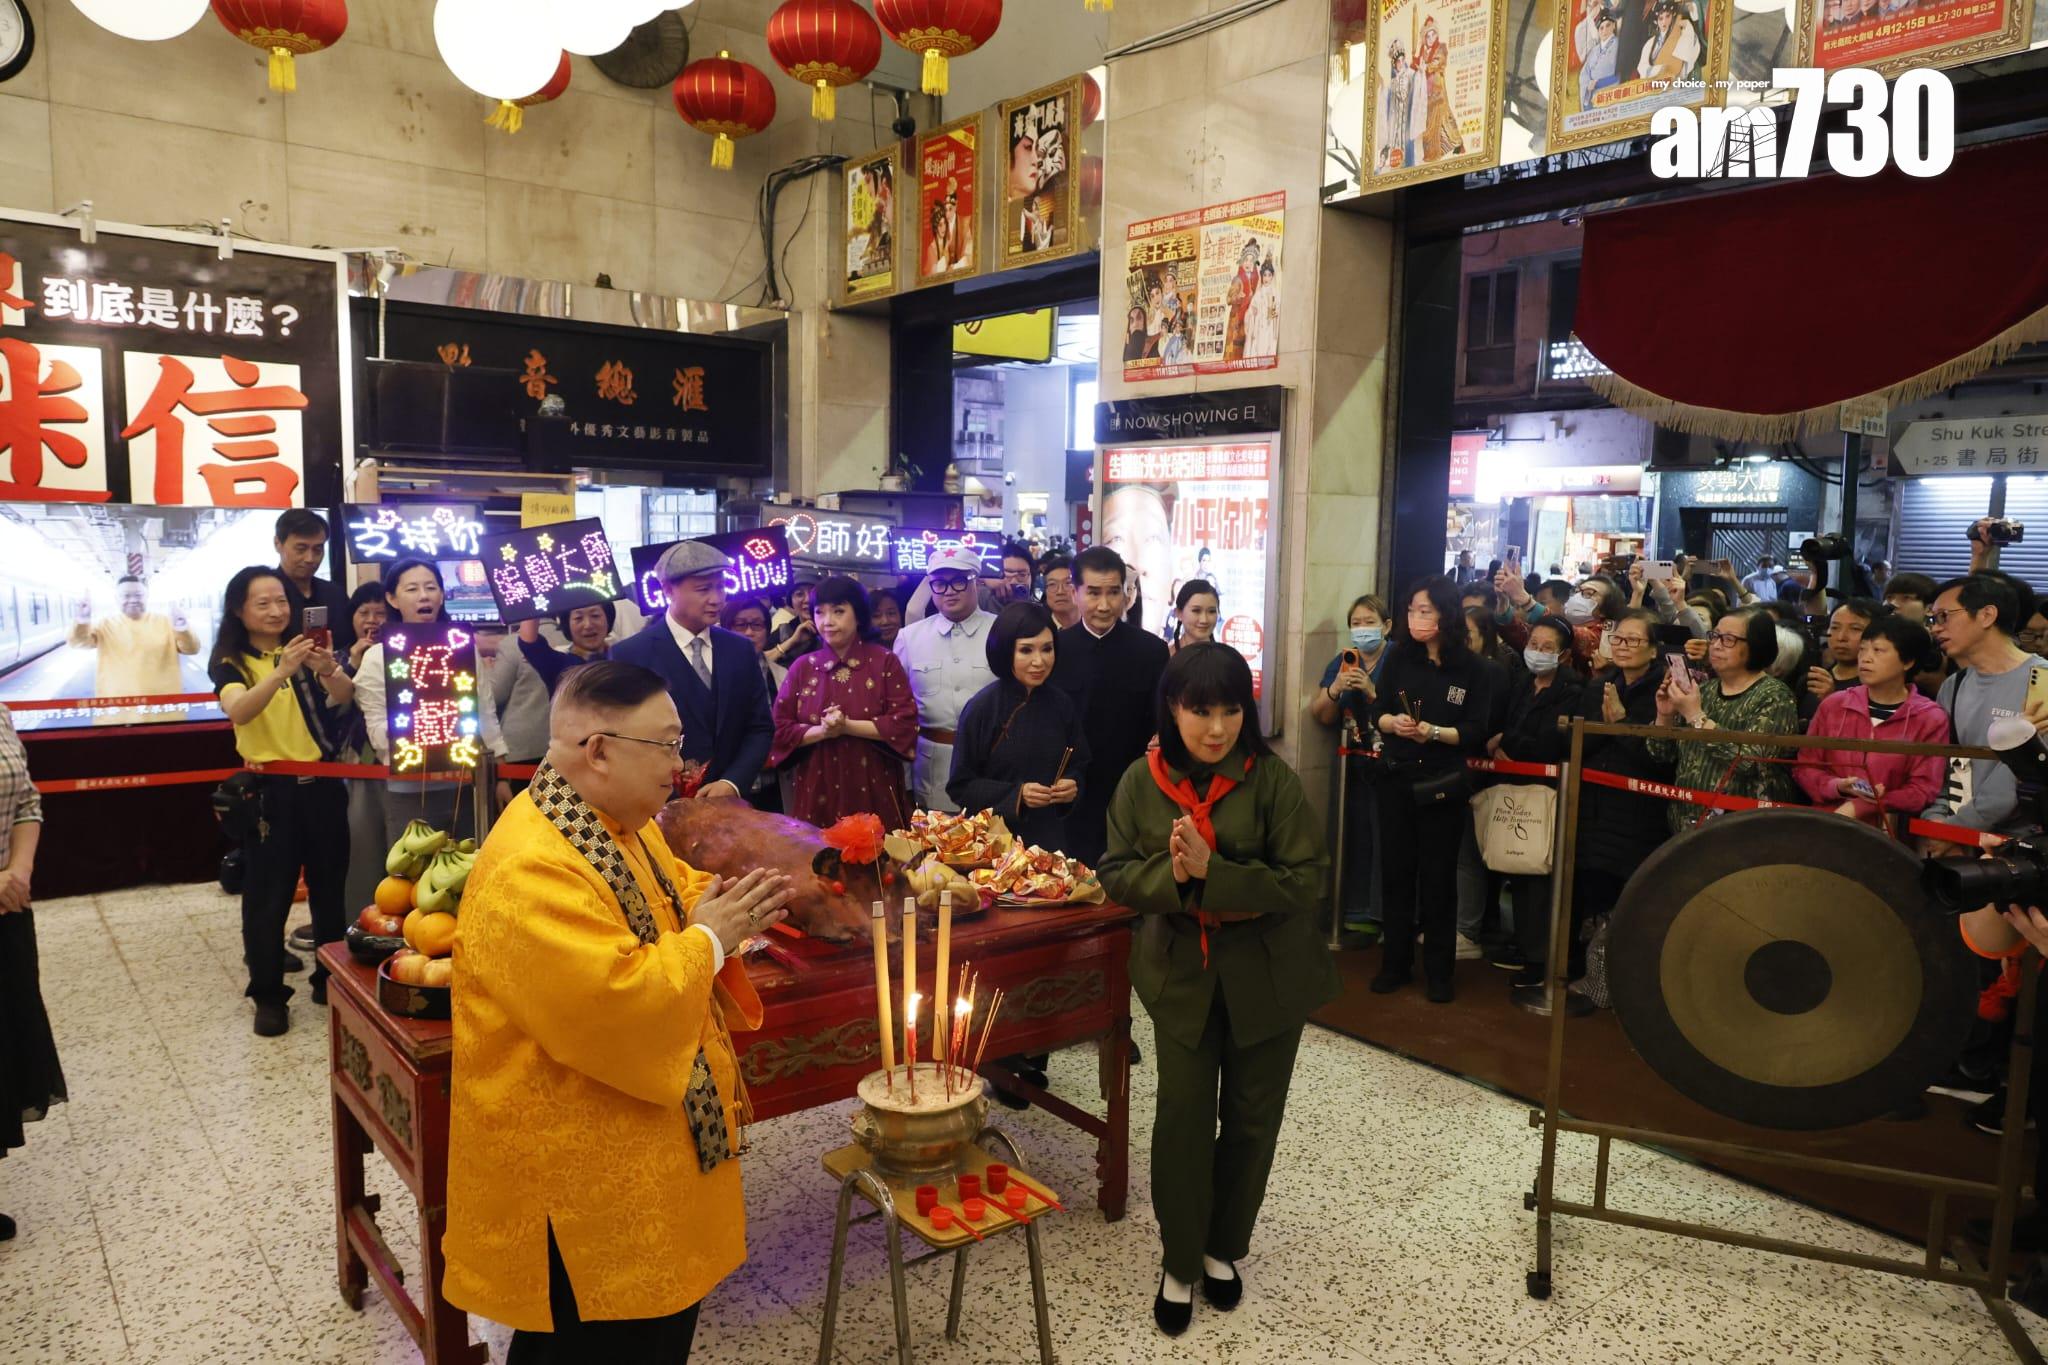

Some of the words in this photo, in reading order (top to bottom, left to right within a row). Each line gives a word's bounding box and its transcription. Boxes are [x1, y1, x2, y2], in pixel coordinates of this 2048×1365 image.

[1875, 16, 1926, 39] 4月12-15日
[1124, 415, 1160, 430] NOW
[1163, 407, 1238, 427] SHOWING
[1931, 427, 1963, 441] Shu
[1971, 425, 2004, 439] Kuk
[1956, 446, 2040, 467] 書局街
[349, 516, 484, 557] 支持你
[785, 515, 890, 561] 大師好
[723, 554, 788, 594] Show
[409, 645, 461, 747] 好戲
